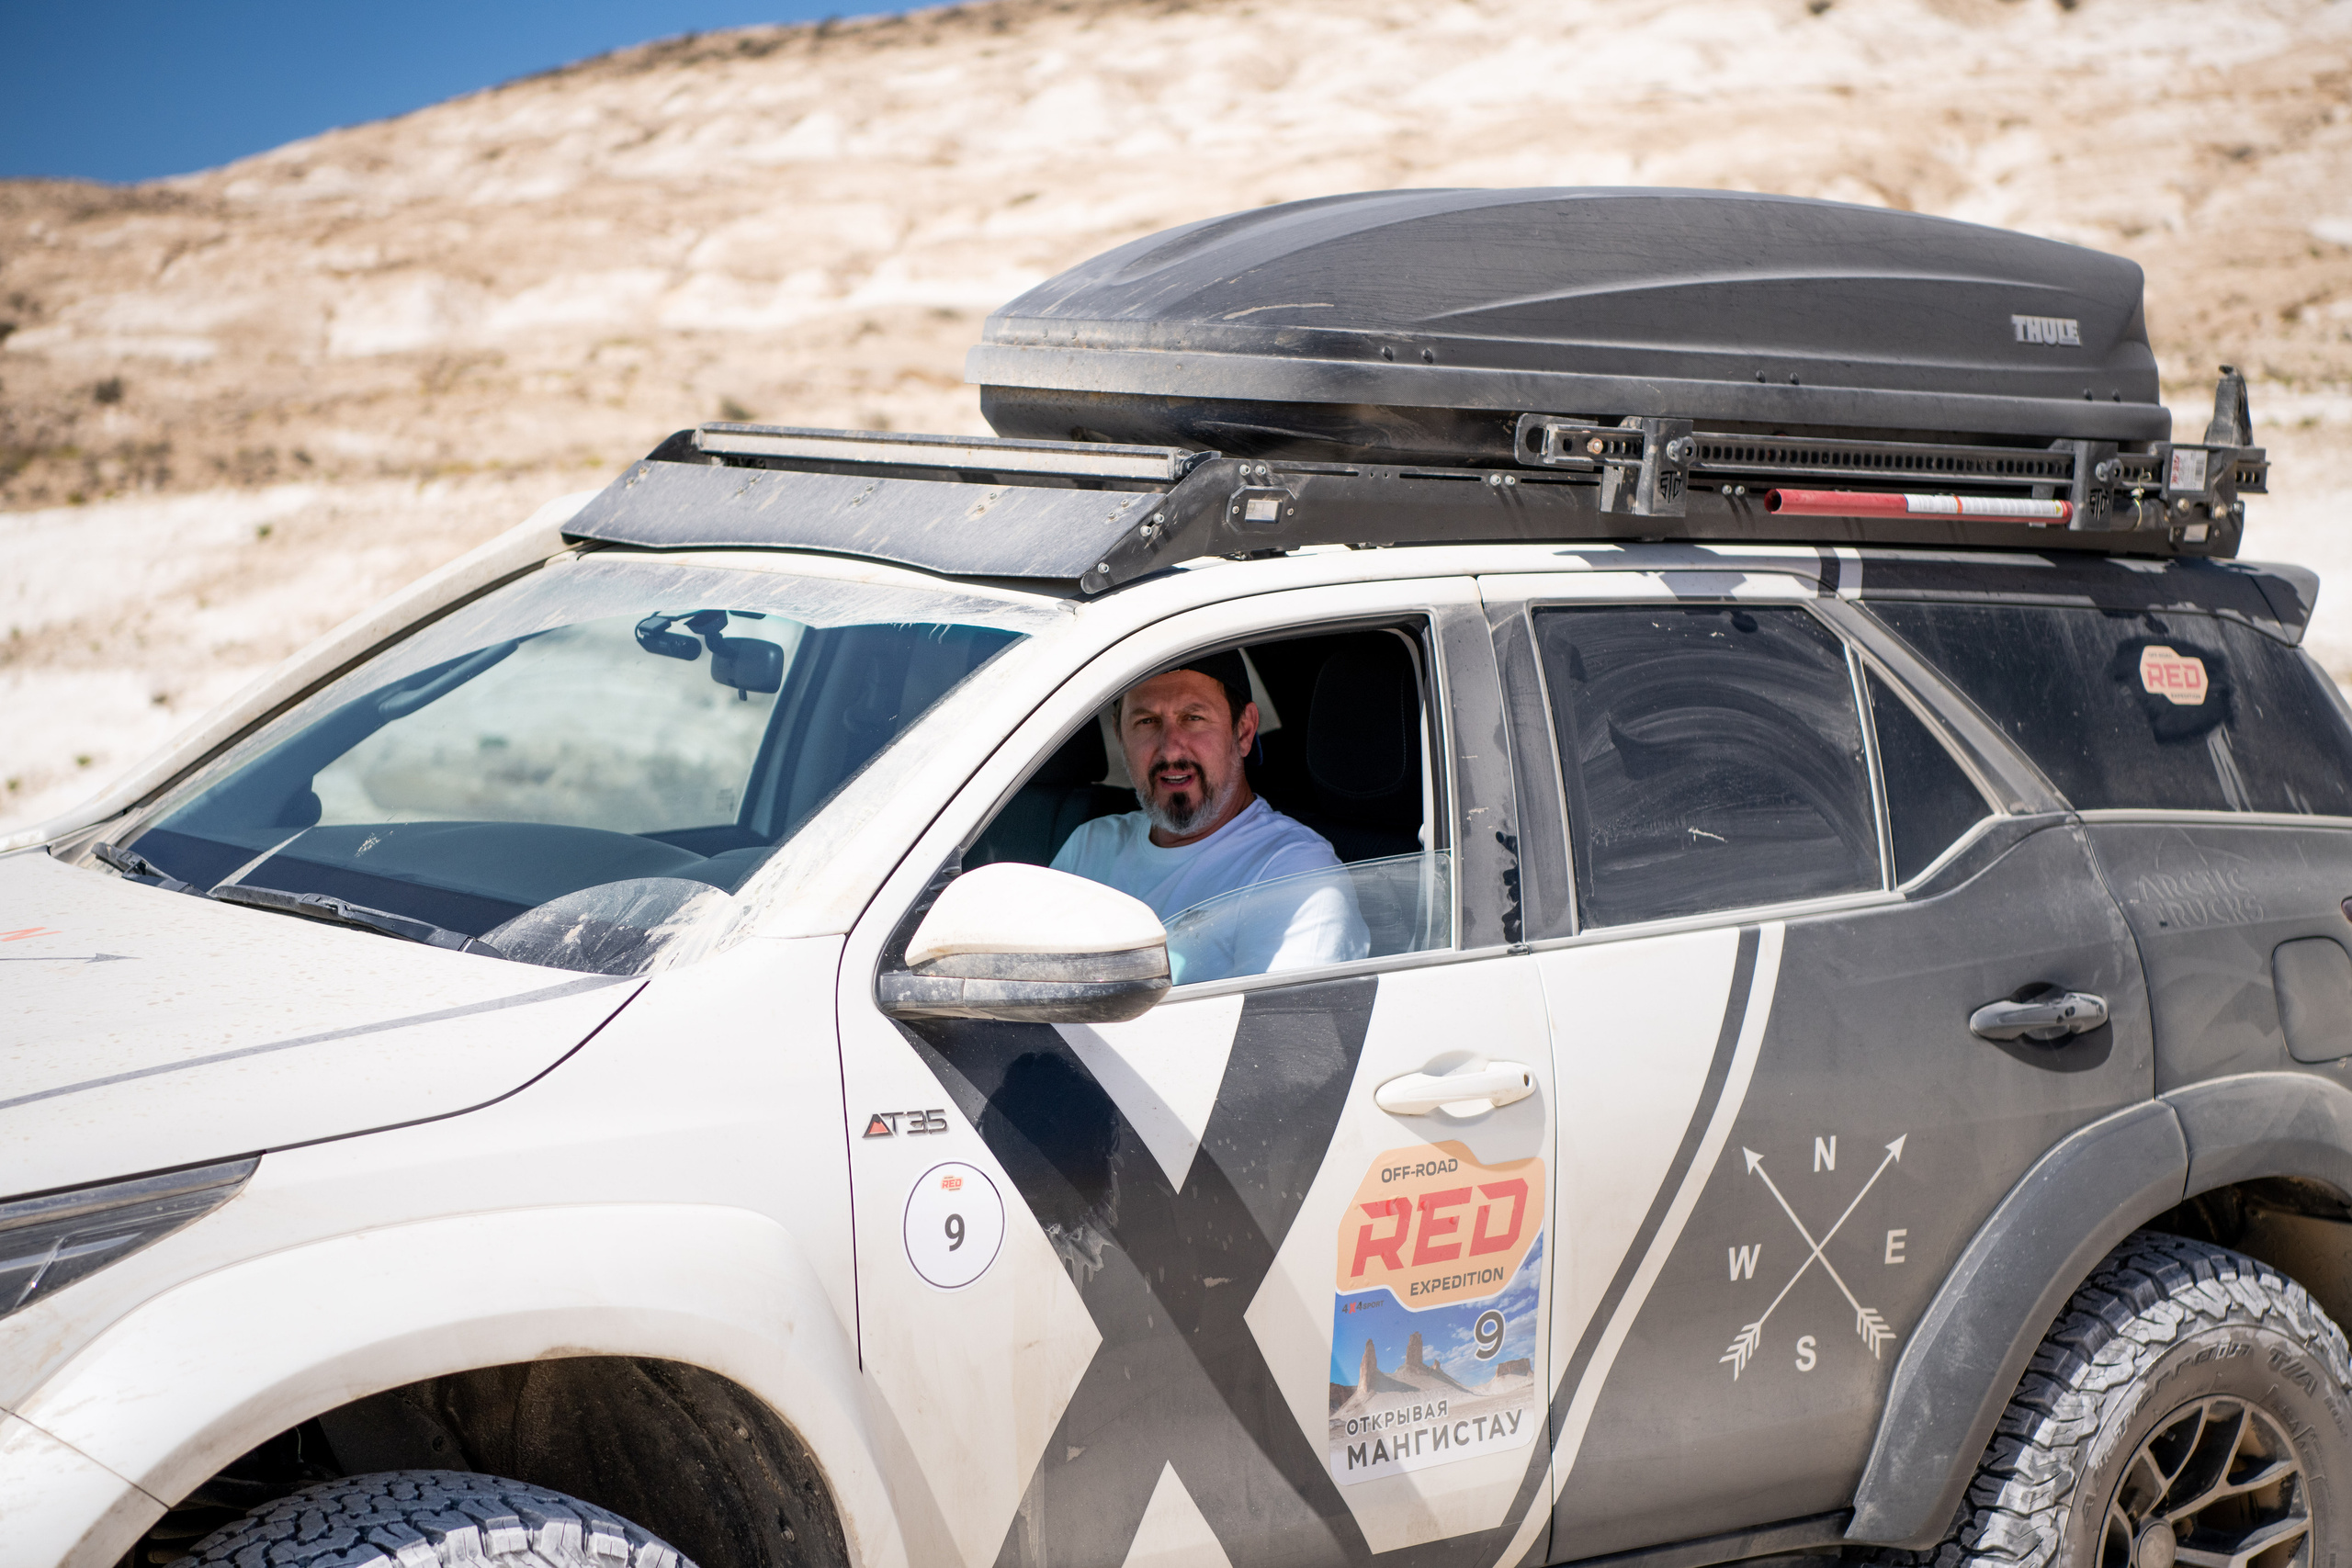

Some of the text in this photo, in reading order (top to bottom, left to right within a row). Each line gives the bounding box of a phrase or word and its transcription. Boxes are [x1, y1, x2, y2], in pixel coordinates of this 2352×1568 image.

[2012, 314, 2081, 346] THULE
[2145, 663, 2201, 689] RED
[862, 1108, 951, 1140] AT35
[1380, 1158, 1459, 1184] OFF-ROAD
[1814, 1134, 1837, 1172] N
[942, 1179, 962, 1189] RED
[944, 1213, 966, 1252] 9
[1350, 1177, 1530, 1278] RED
[1728, 1243, 1762, 1281] W
[1884, 1228, 1908, 1265] E
[1409, 1267, 1505, 1296] EXPEDITION
[1474, 1309, 1506, 1361] 9
[1794, 1335, 1817, 1372] S
[1346, 1399, 1448, 1436] ОТКРЫВАЯ
[1347, 1408, 1522, 1471] МАНГИСТАУ
